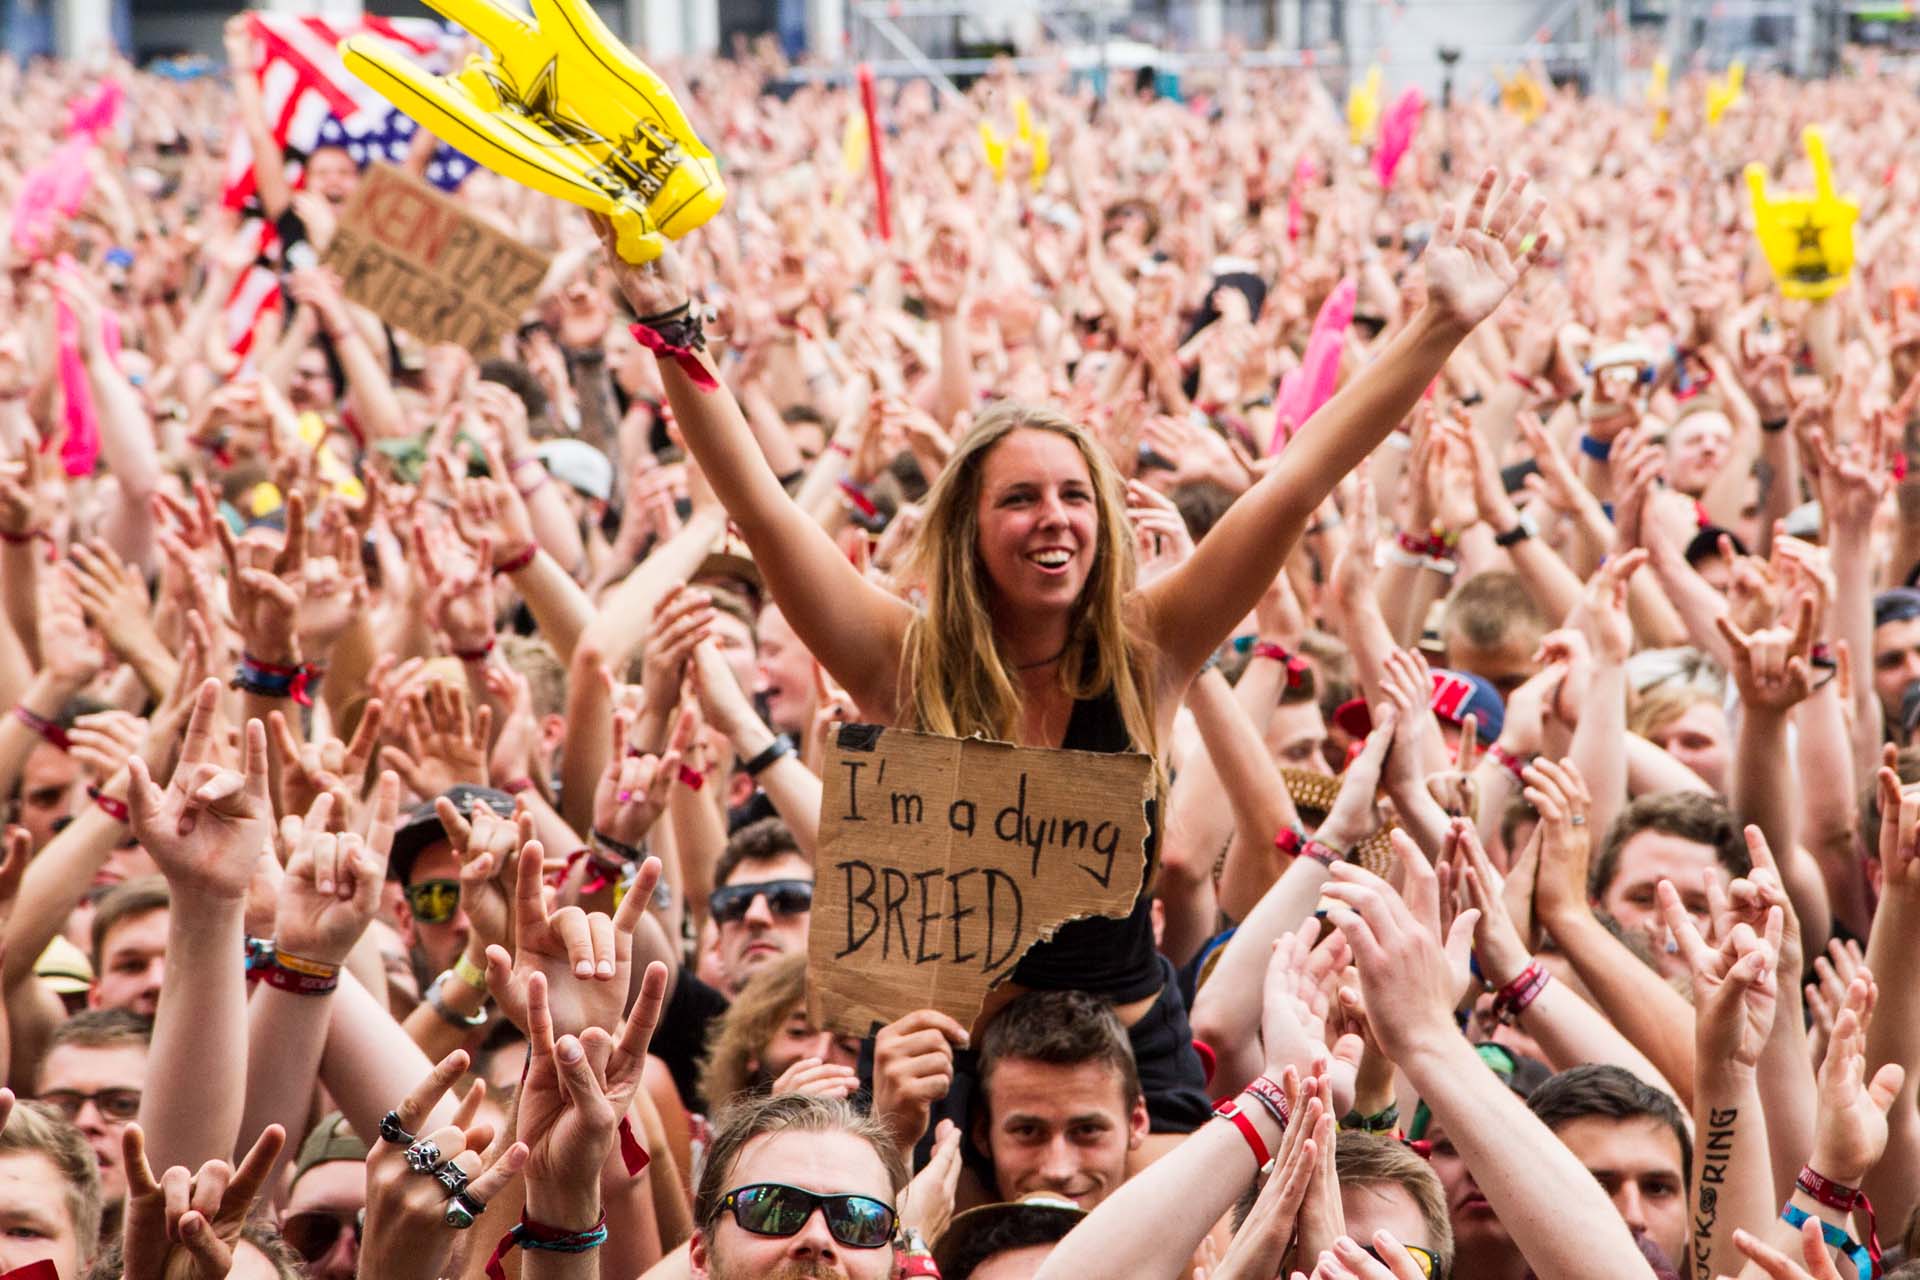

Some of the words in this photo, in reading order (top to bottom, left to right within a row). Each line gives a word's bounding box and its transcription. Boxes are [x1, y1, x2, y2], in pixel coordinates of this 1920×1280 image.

[841, 758, 923, 824] I'm
[949, 799, 977, 838] a
[994, 772, 1121, 889] dying
[835, 860, 1024, 973] BREED
[1702, 1108, 1737, 1184] RING
